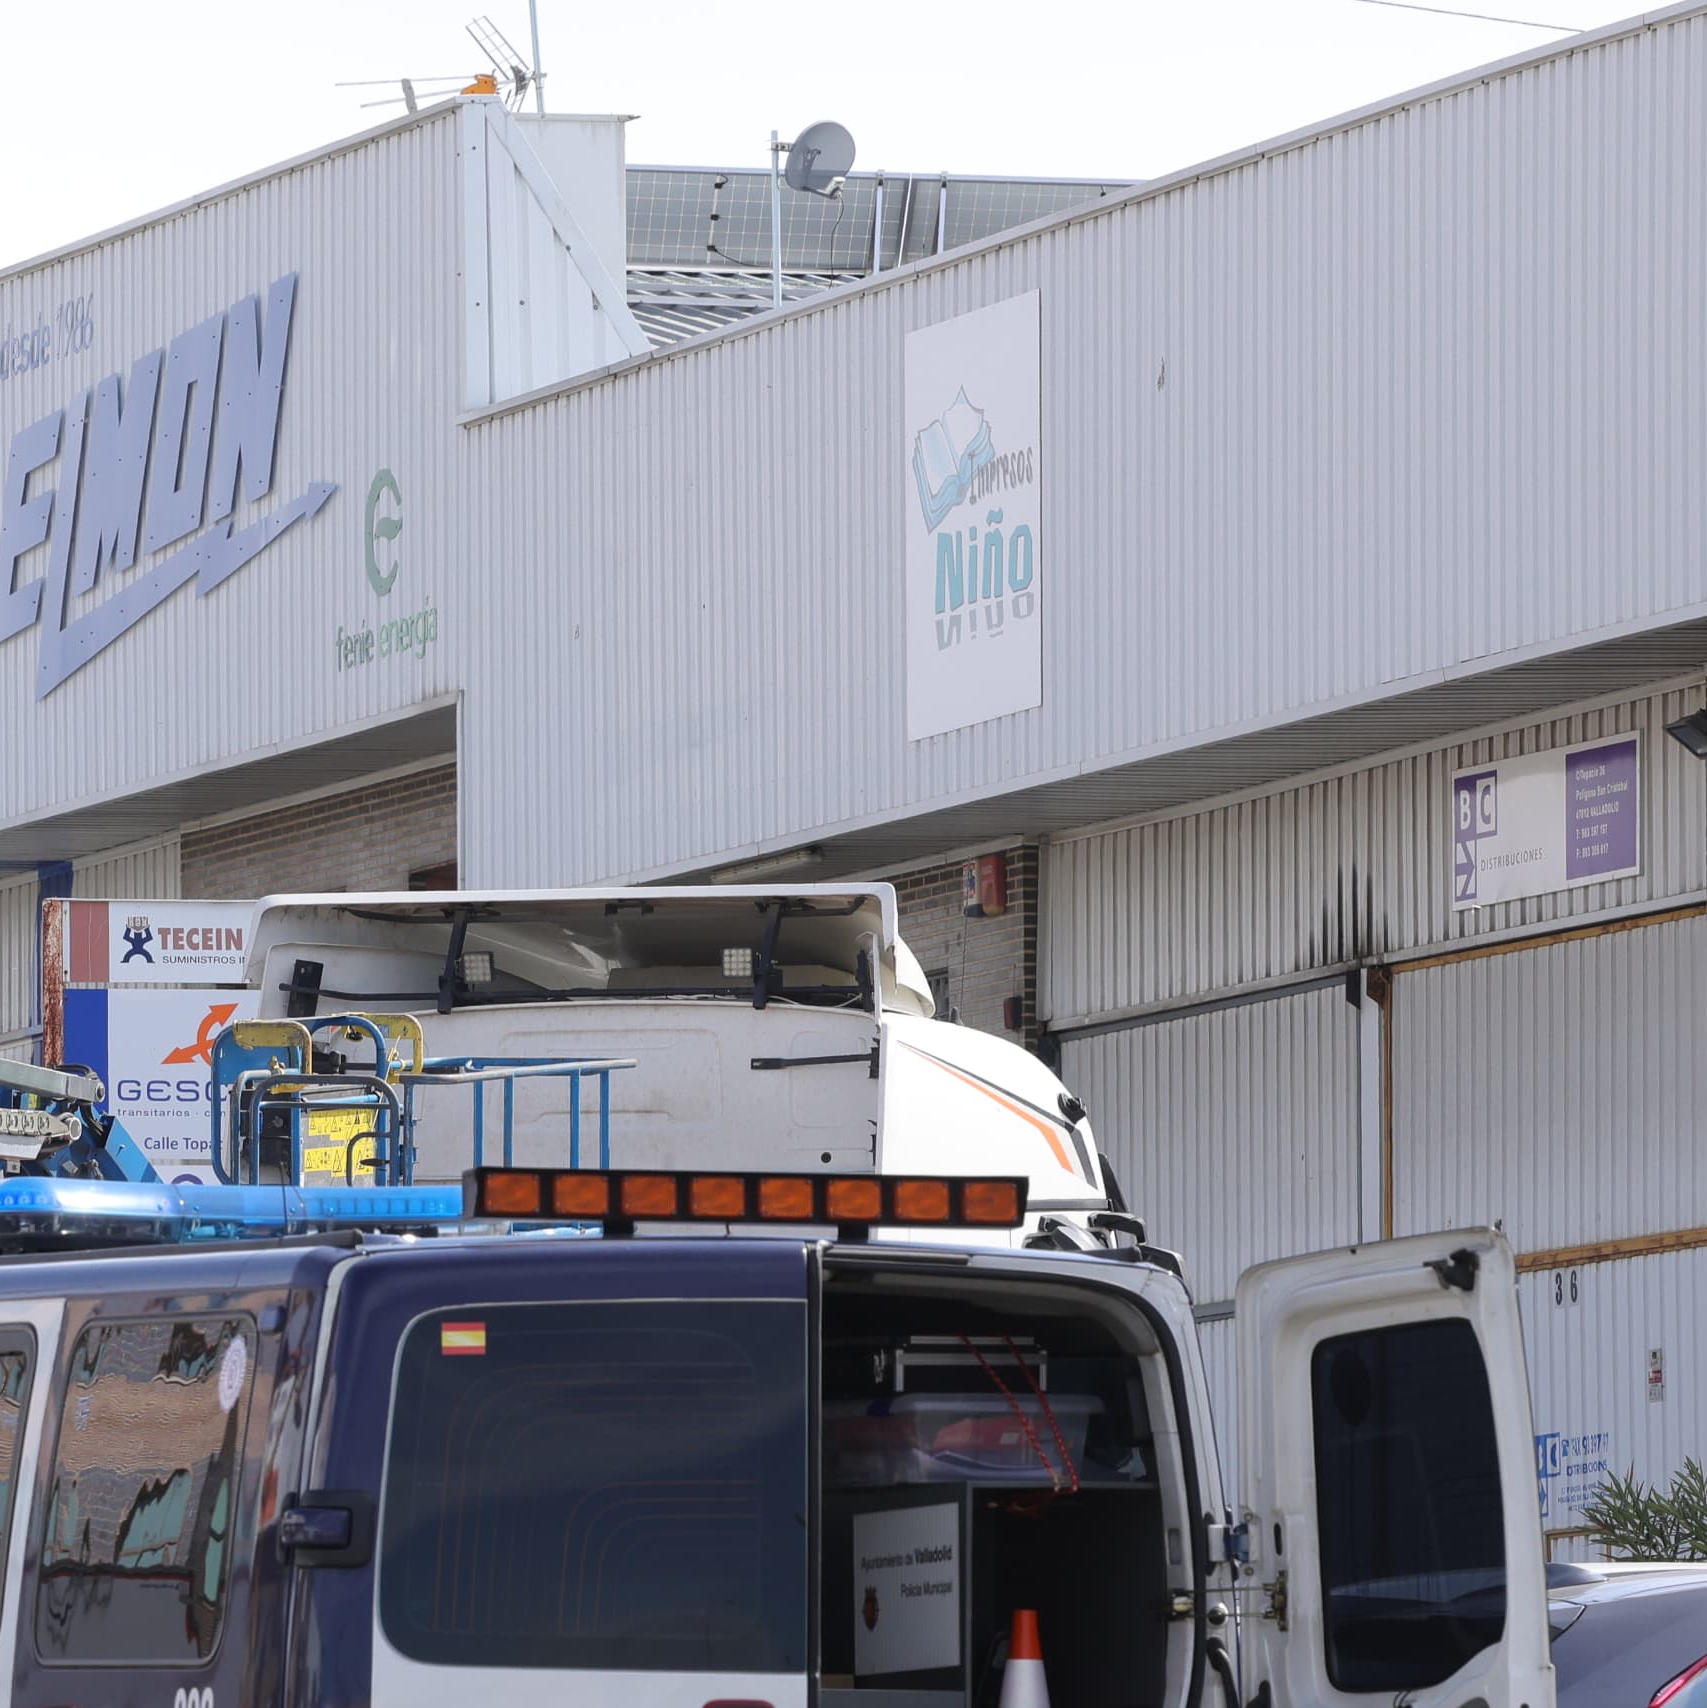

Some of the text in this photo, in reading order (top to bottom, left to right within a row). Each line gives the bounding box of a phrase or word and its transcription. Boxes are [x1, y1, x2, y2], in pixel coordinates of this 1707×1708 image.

[0, 315, 50, 380] desde
[968, 446, 1034, 505] Impresos
[935, 507, 1033, 614] Niño
[1480, 847, 1544, 872] DISTRIBUCIONES
[158, 928, 243, 951] TECEIN
[162, 956, 236, 965] SUMINISTROS
[117, 1108, 190, 1118] transitarios
[144, 1137, 179, 1150] Calle
[914, 1544, 953, 1565] Valladolid
